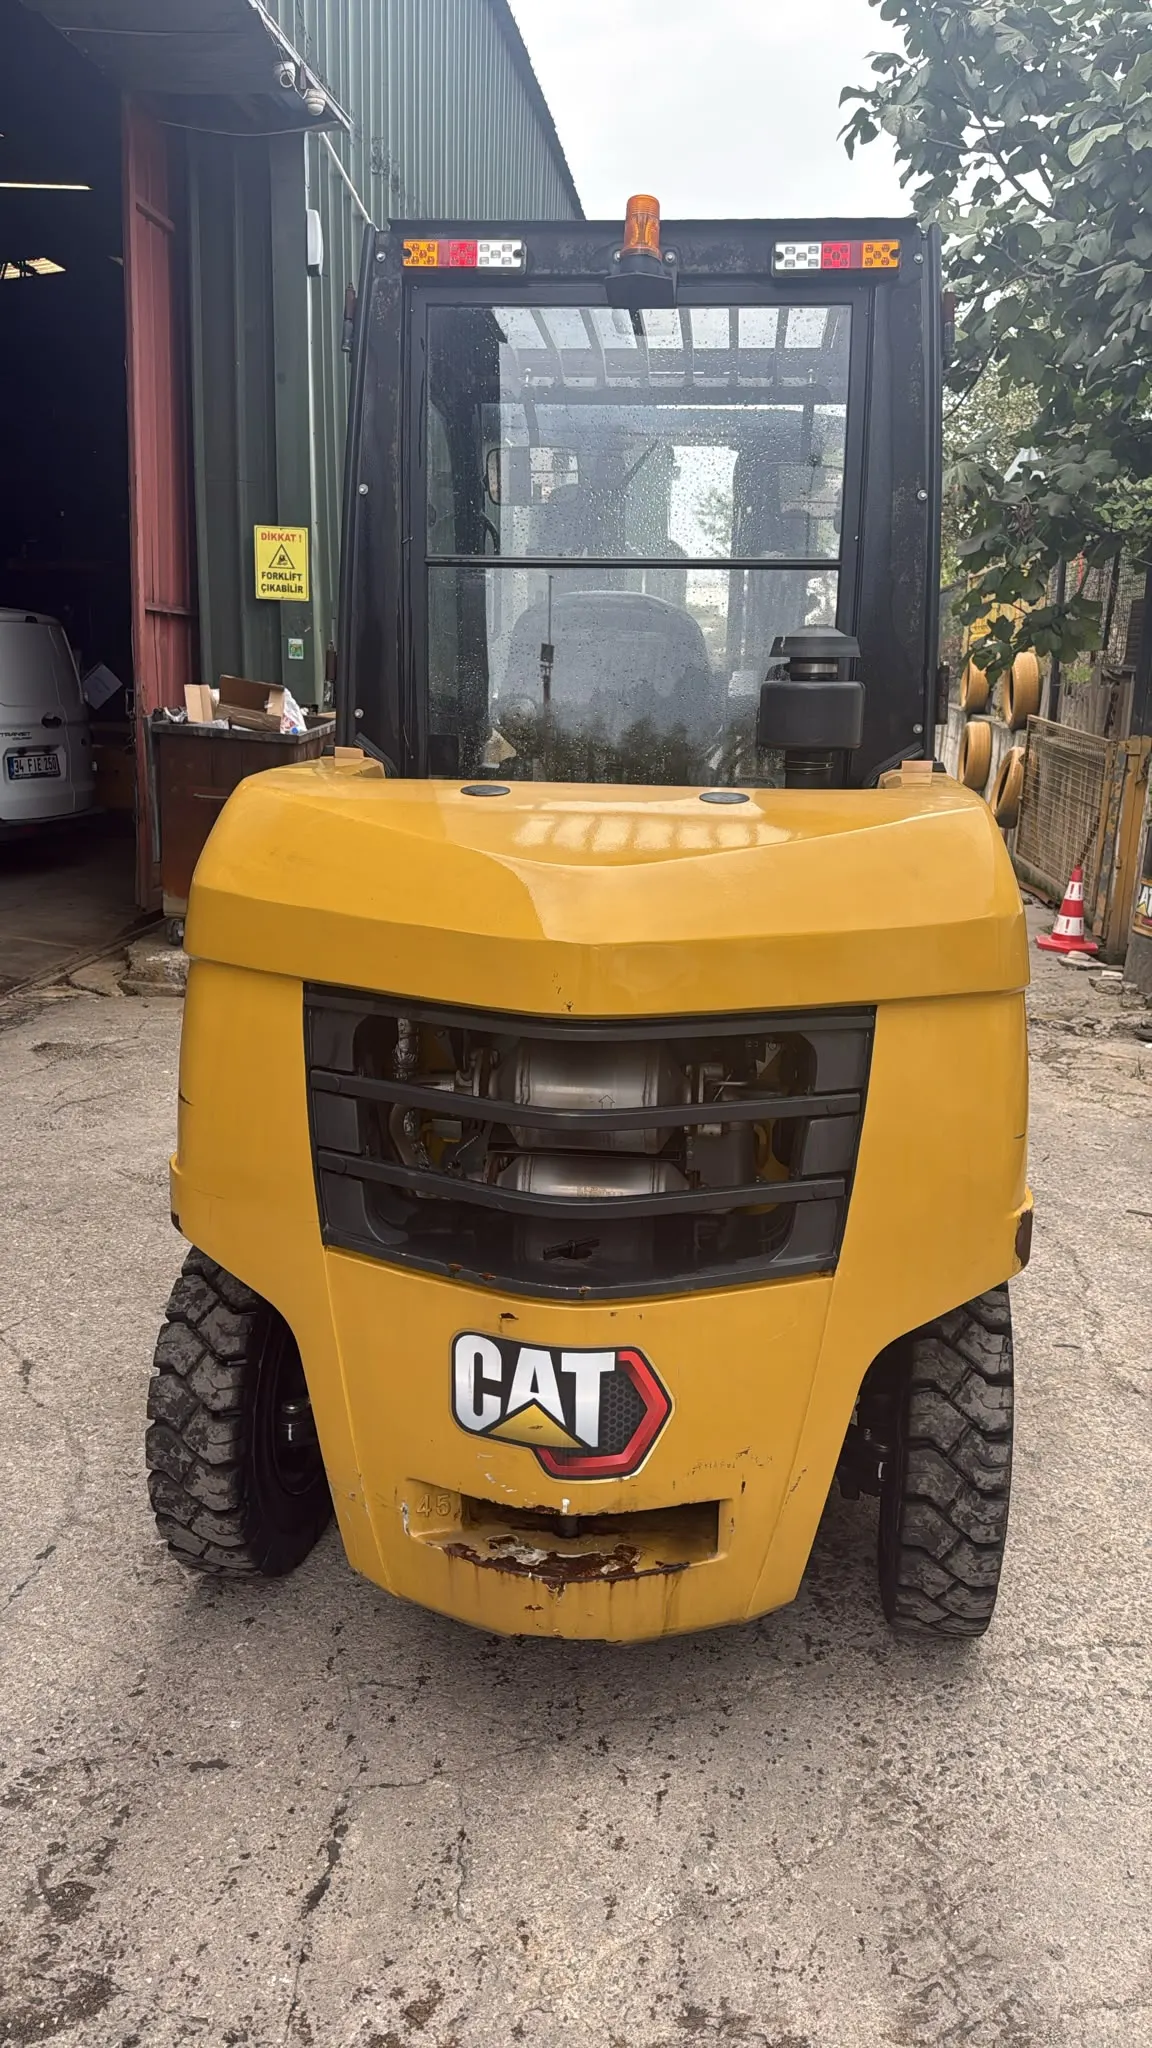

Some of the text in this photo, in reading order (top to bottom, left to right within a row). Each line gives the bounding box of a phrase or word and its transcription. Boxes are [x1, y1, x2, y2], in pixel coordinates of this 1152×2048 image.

[261, 531, 297, 542] DİKKAT
[261, 571, 303, 582] FORKLİFT
[261, 583, 304, 594] ÇIKABİLİR
[14, 756, 57, 773] 34 FIE 250
[455, 1334, 616, 1448] CAT
[416, 1493, 452, 1517] 45
